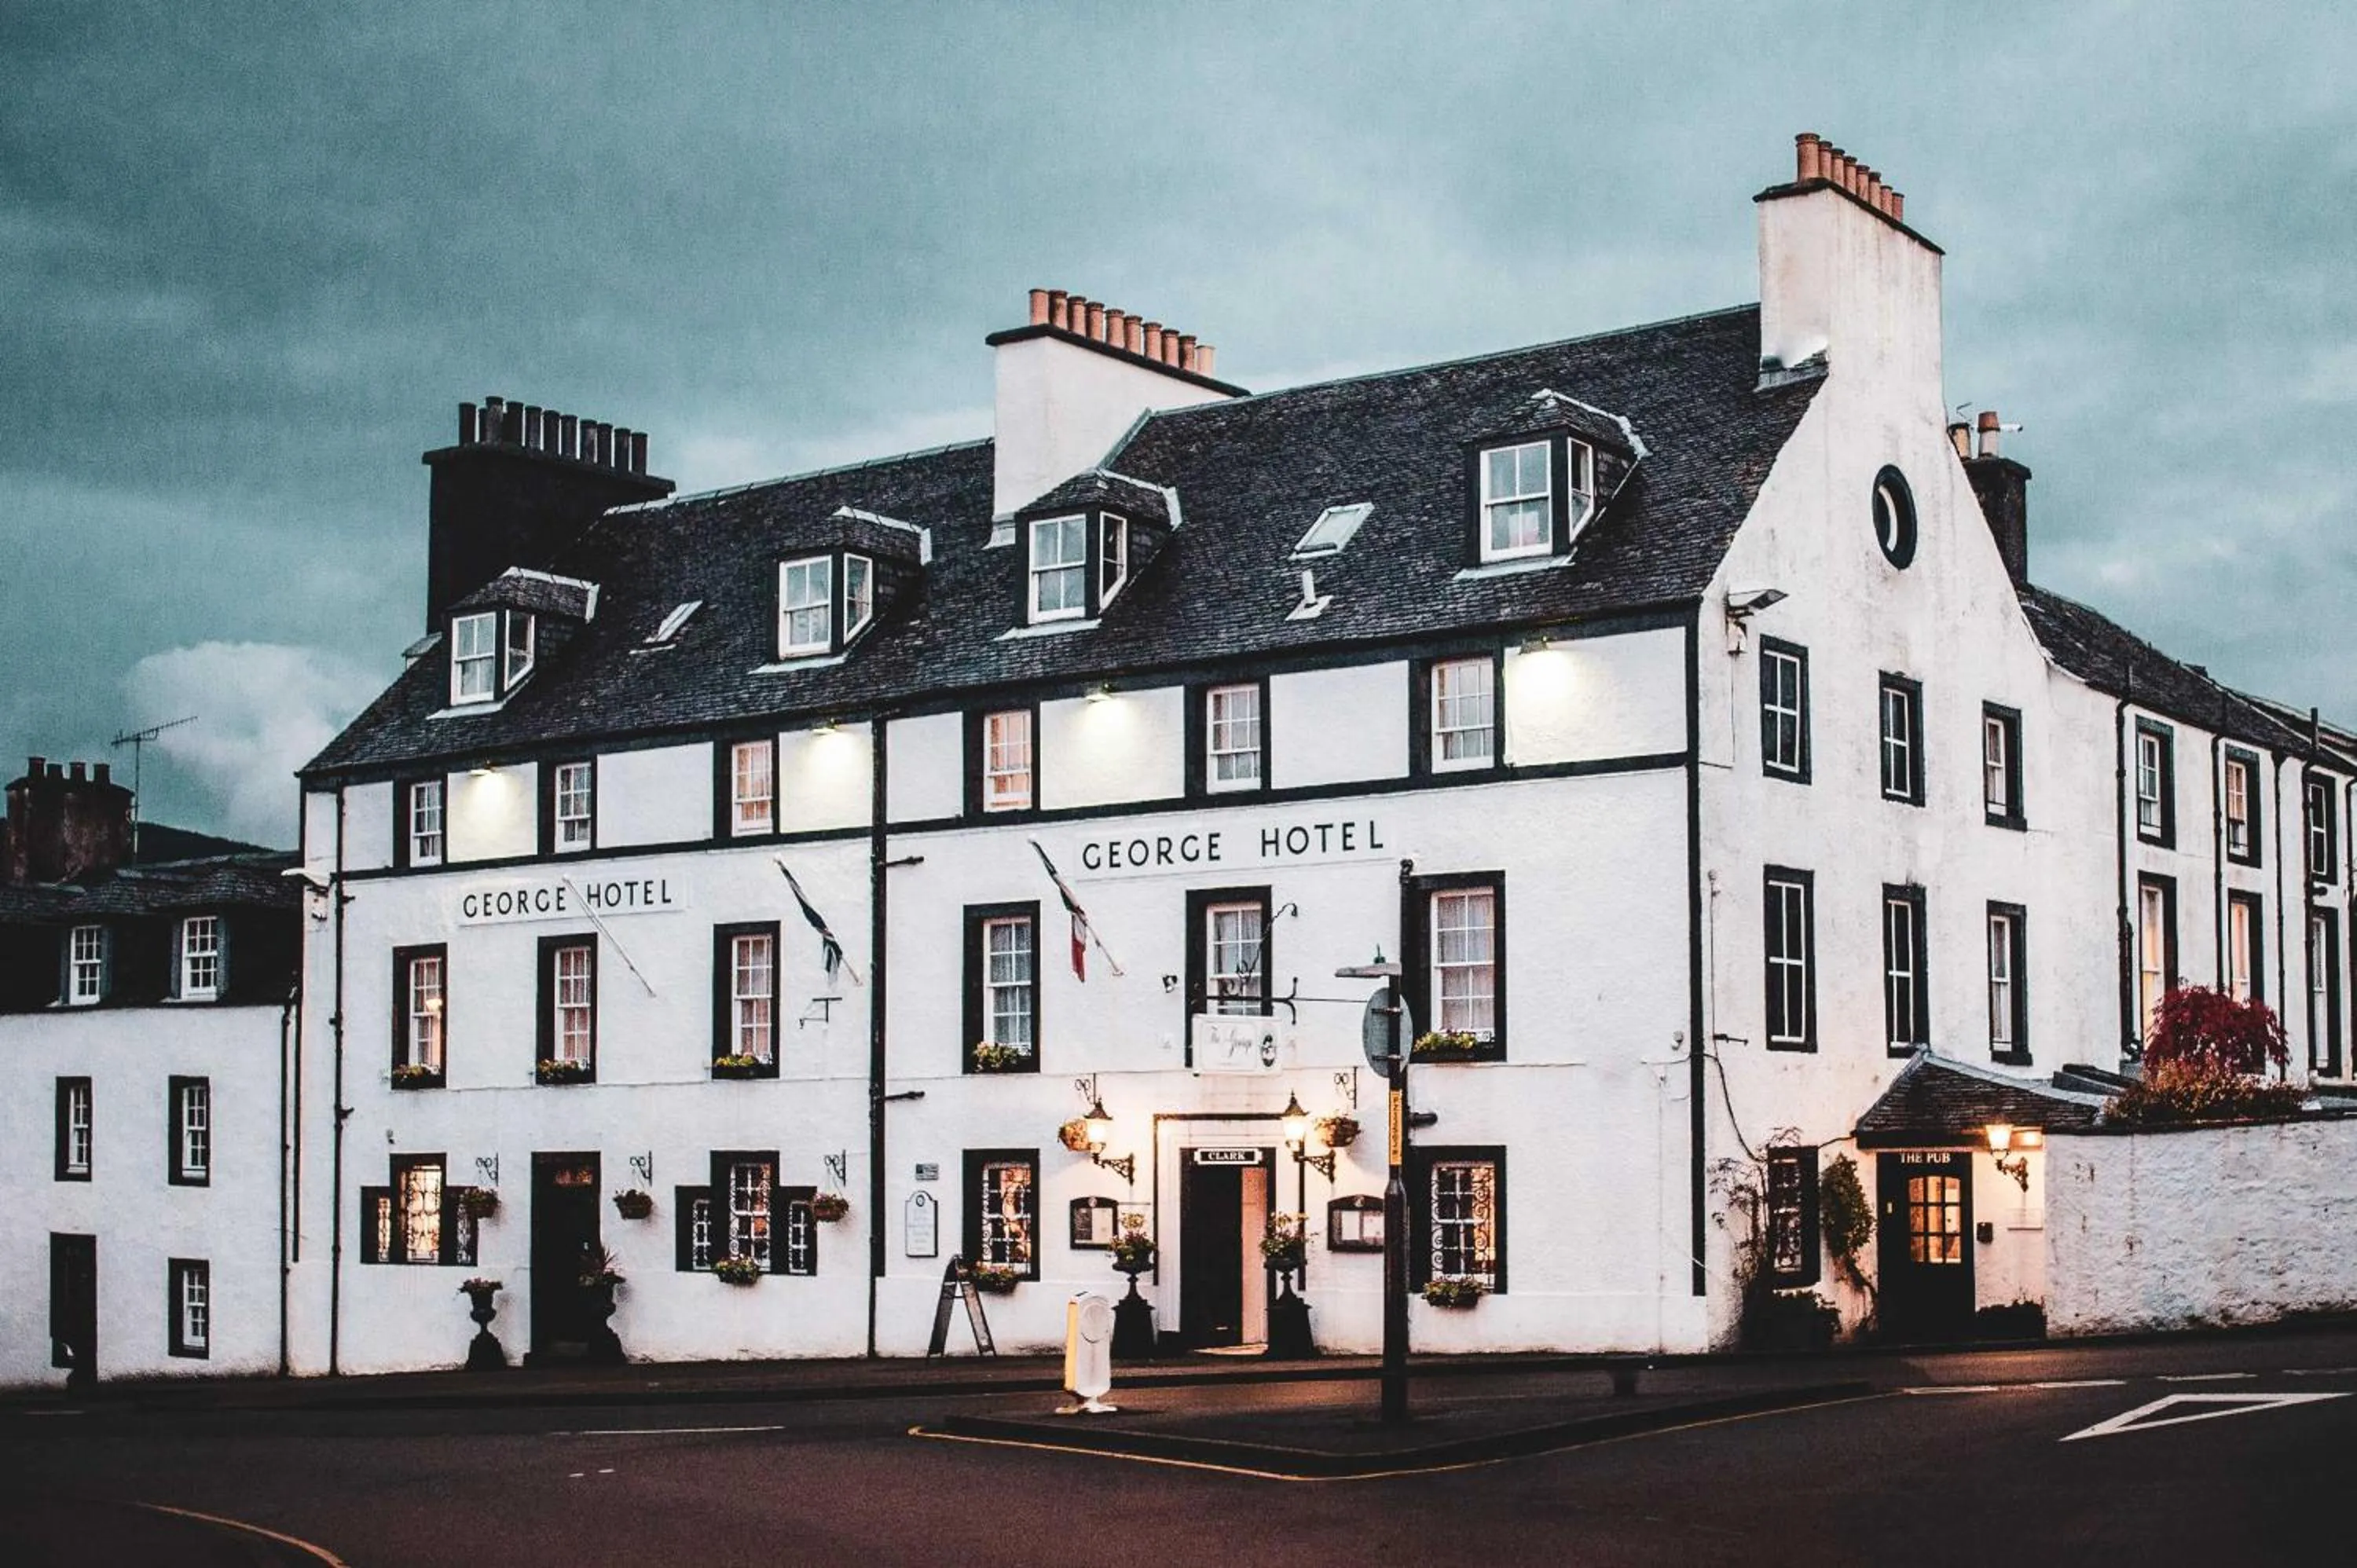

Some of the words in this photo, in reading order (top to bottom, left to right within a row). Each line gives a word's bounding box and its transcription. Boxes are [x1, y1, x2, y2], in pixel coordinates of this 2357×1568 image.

[1083, 833, 1222, 870] GEORGE
[1261, 820, 1384, 857] HOTEL
[463, 887, 566, 918] GEORGE
[587, 880, 672, 908] HOTEL
[1208, 1150, 1245, 1160] CLARK
[1901, 1152, 1923, 1163] THE
[1926, 1152, 1951, 1163] PUB
